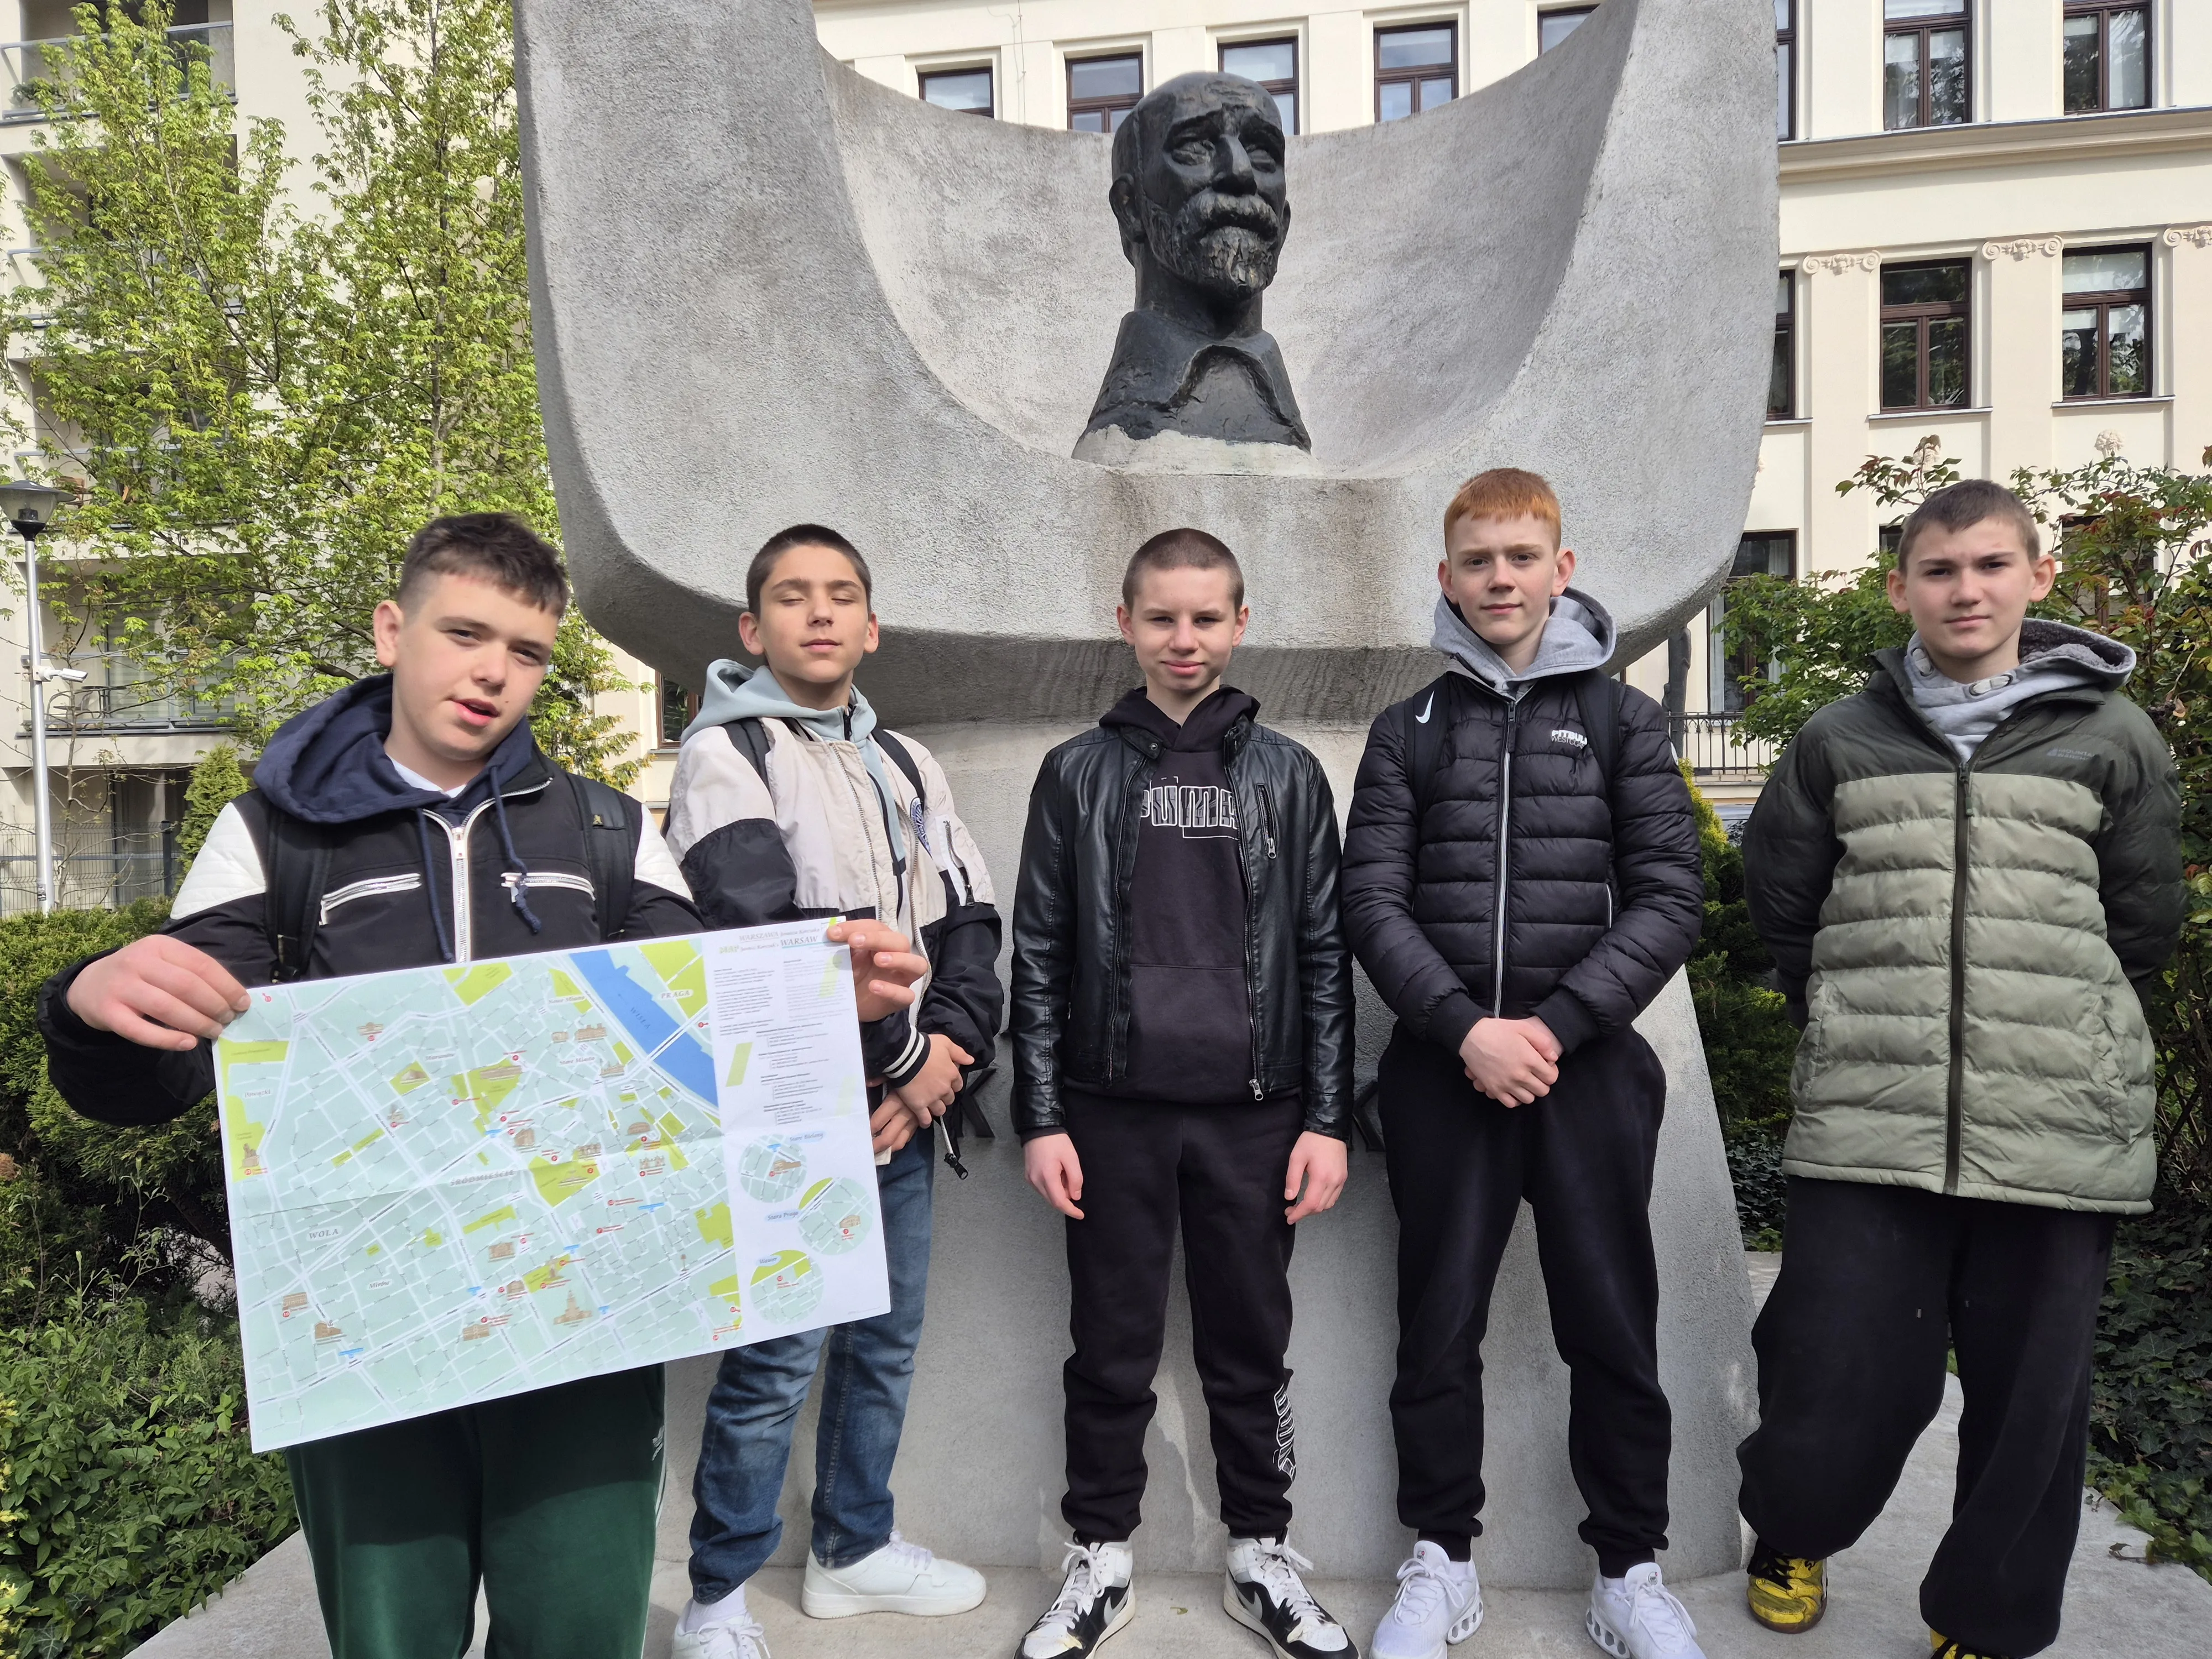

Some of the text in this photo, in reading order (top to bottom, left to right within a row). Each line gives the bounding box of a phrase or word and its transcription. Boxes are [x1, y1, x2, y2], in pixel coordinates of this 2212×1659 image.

[780, 935, 818, 946] WARSAW
[661, 990, 691, 999] PRAGA
[309, 1228, 339, 1240] WOLA
